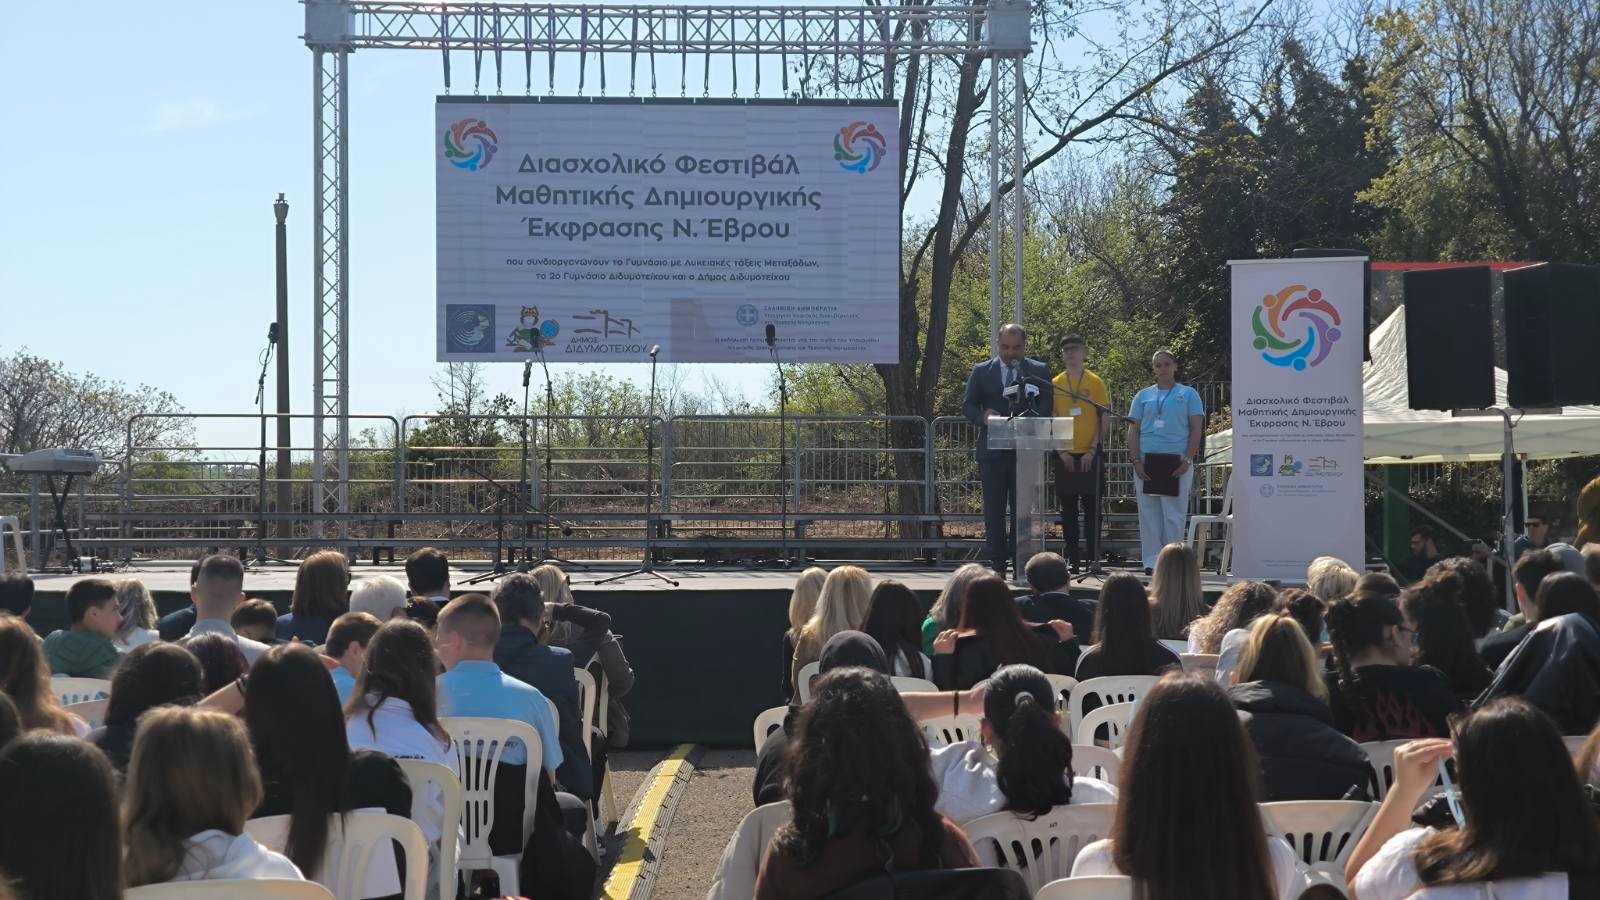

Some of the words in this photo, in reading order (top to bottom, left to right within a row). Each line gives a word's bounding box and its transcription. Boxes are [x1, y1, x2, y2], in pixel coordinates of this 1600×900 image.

[518, 153, 666, 174] Διασχολικό
[675, 153, 800, 178] Φεστιβάλ
[496, 184, 634, 209] Μαθητικής
[644, 185, 822, 211] Δημιουργικής
[521, 217, 663, 241] Έκφρασης
[673, 218, 698, 238] Ν.
[701, 217, 790, 241] Έβρου
[506, 258, 523, 266] που
[526, 257, 609, 266] συνδιοργανώνουν
[612, 258, 623, 266] το
[626, 257, 668, 266] Γυμνάσιο
[670, 259, 681, 267] με
[684, 258, 731, 268] Λυκειακές
[734, 258, 762, 268] τάξεις
[549, 272, 561, 280] 2ο
[564, 271, 606, 281] Γυμνάσιο
[609, 271, 670, 281] Διδυμοτείχου
[672, 273, 686, 281] και
[698, 273, 727, 282] Δήμος
[729, 273, 790, 282] Διδυμοτείχου
[570, 336, 599, 344] ΔΗΜΟΣ
[565, 344, 649, 353] ΔΙΔΥΜΟΤΕΙΧΟΥ
[1246, 397, 1300, 405] Διασχολικό
[1302, 396, 1349, 406] Φεστιβάλ
[1238, 408, 1288, 417] Μαθητικής
[1291, 408, 1357, 417] Δημιουργικής
[1248, 419, 1299, 428] Έκφρασης
[1312, 419, 1346, 428] Έβρου
